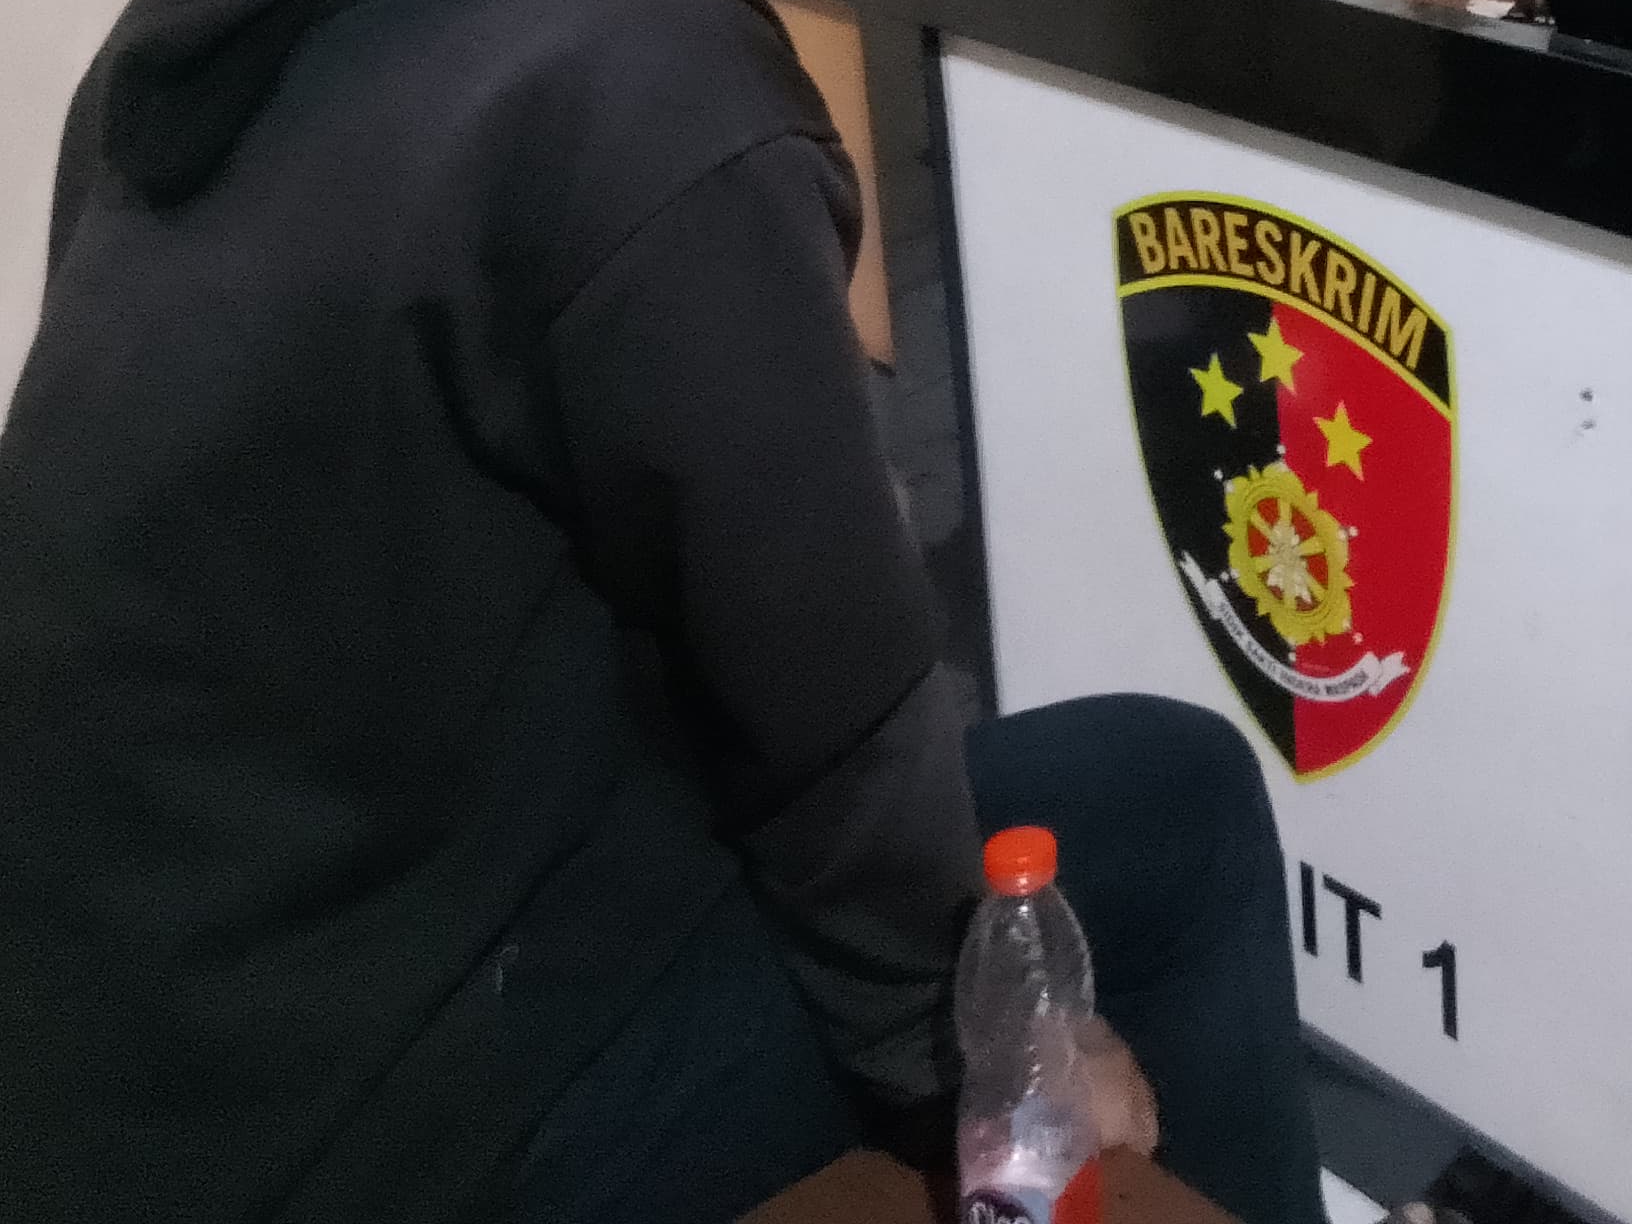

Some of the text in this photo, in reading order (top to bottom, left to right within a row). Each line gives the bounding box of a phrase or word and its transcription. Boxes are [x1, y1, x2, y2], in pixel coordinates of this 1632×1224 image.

[1129, 207, 1428, 371] BARESKRIM
[1300, 861, 1458, 1041] IT 1
